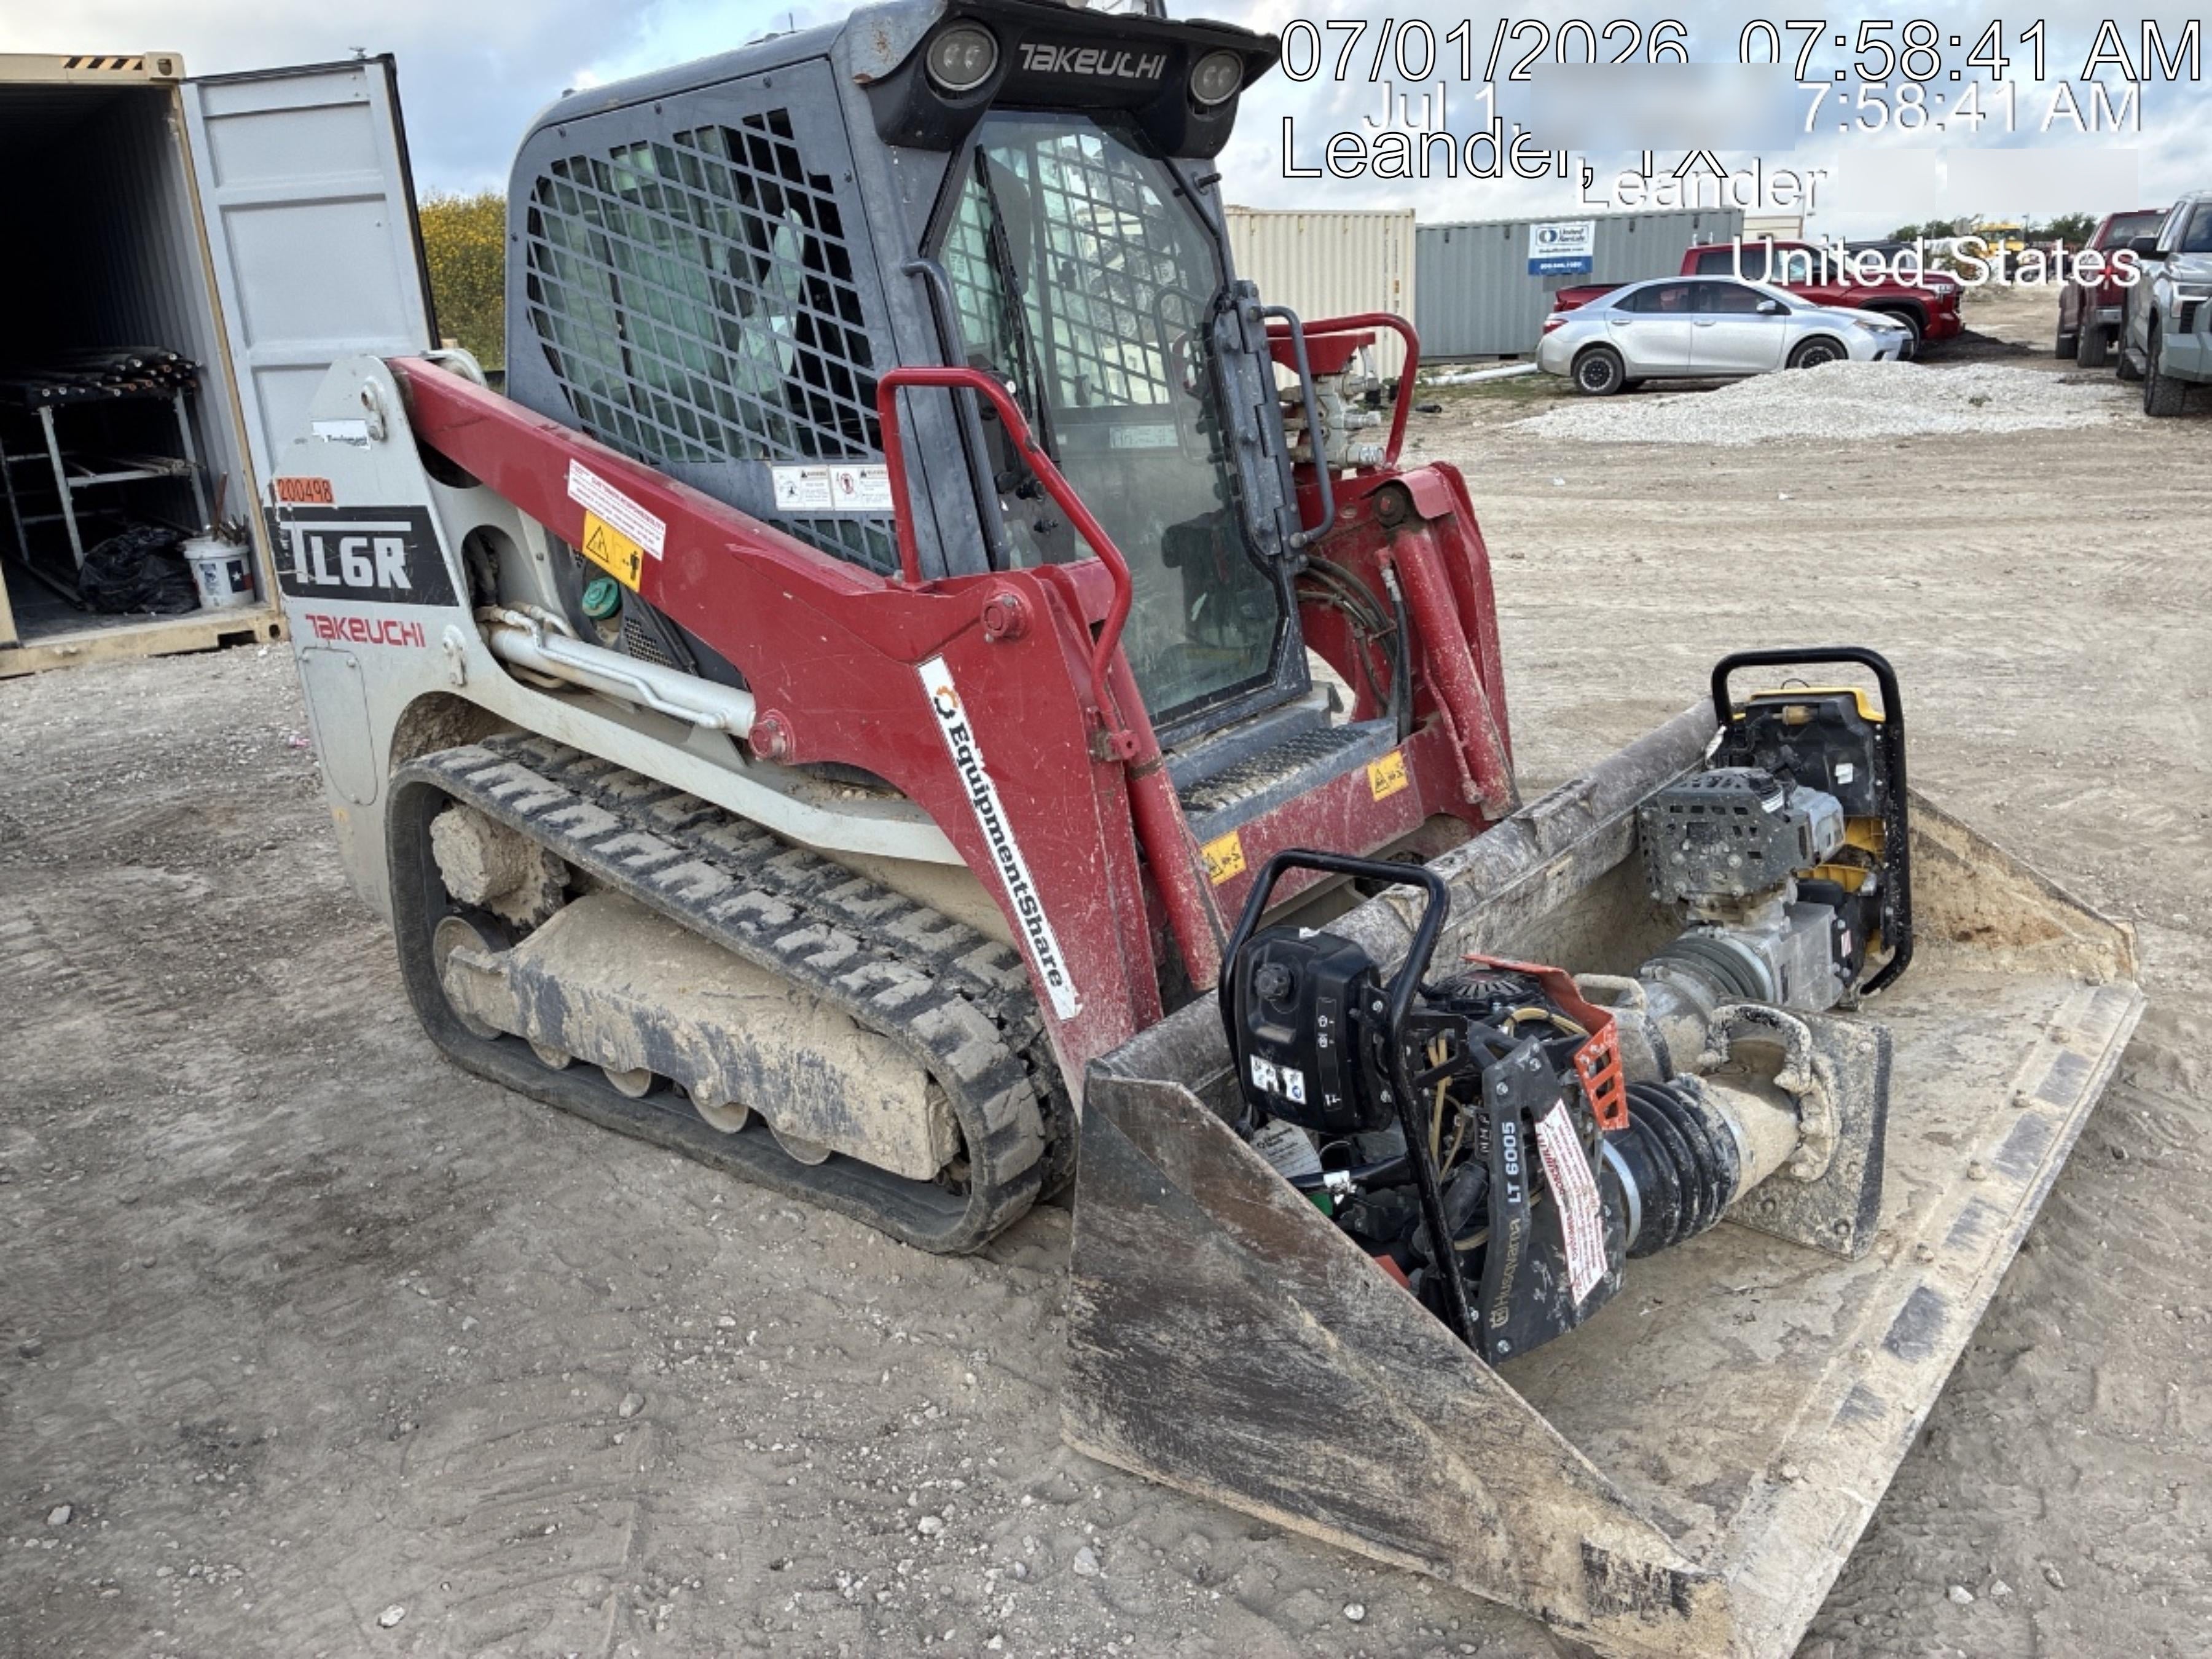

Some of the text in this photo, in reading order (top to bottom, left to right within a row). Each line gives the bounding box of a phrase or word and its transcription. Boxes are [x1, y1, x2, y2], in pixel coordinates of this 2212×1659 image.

[276, 479, 332, 503] 200498
[280, 521, 412, 589] TL6R
[948, 720, 1064, 989] EquipmentShare
[1502, 1121, 1522, 1203] LT 6005
